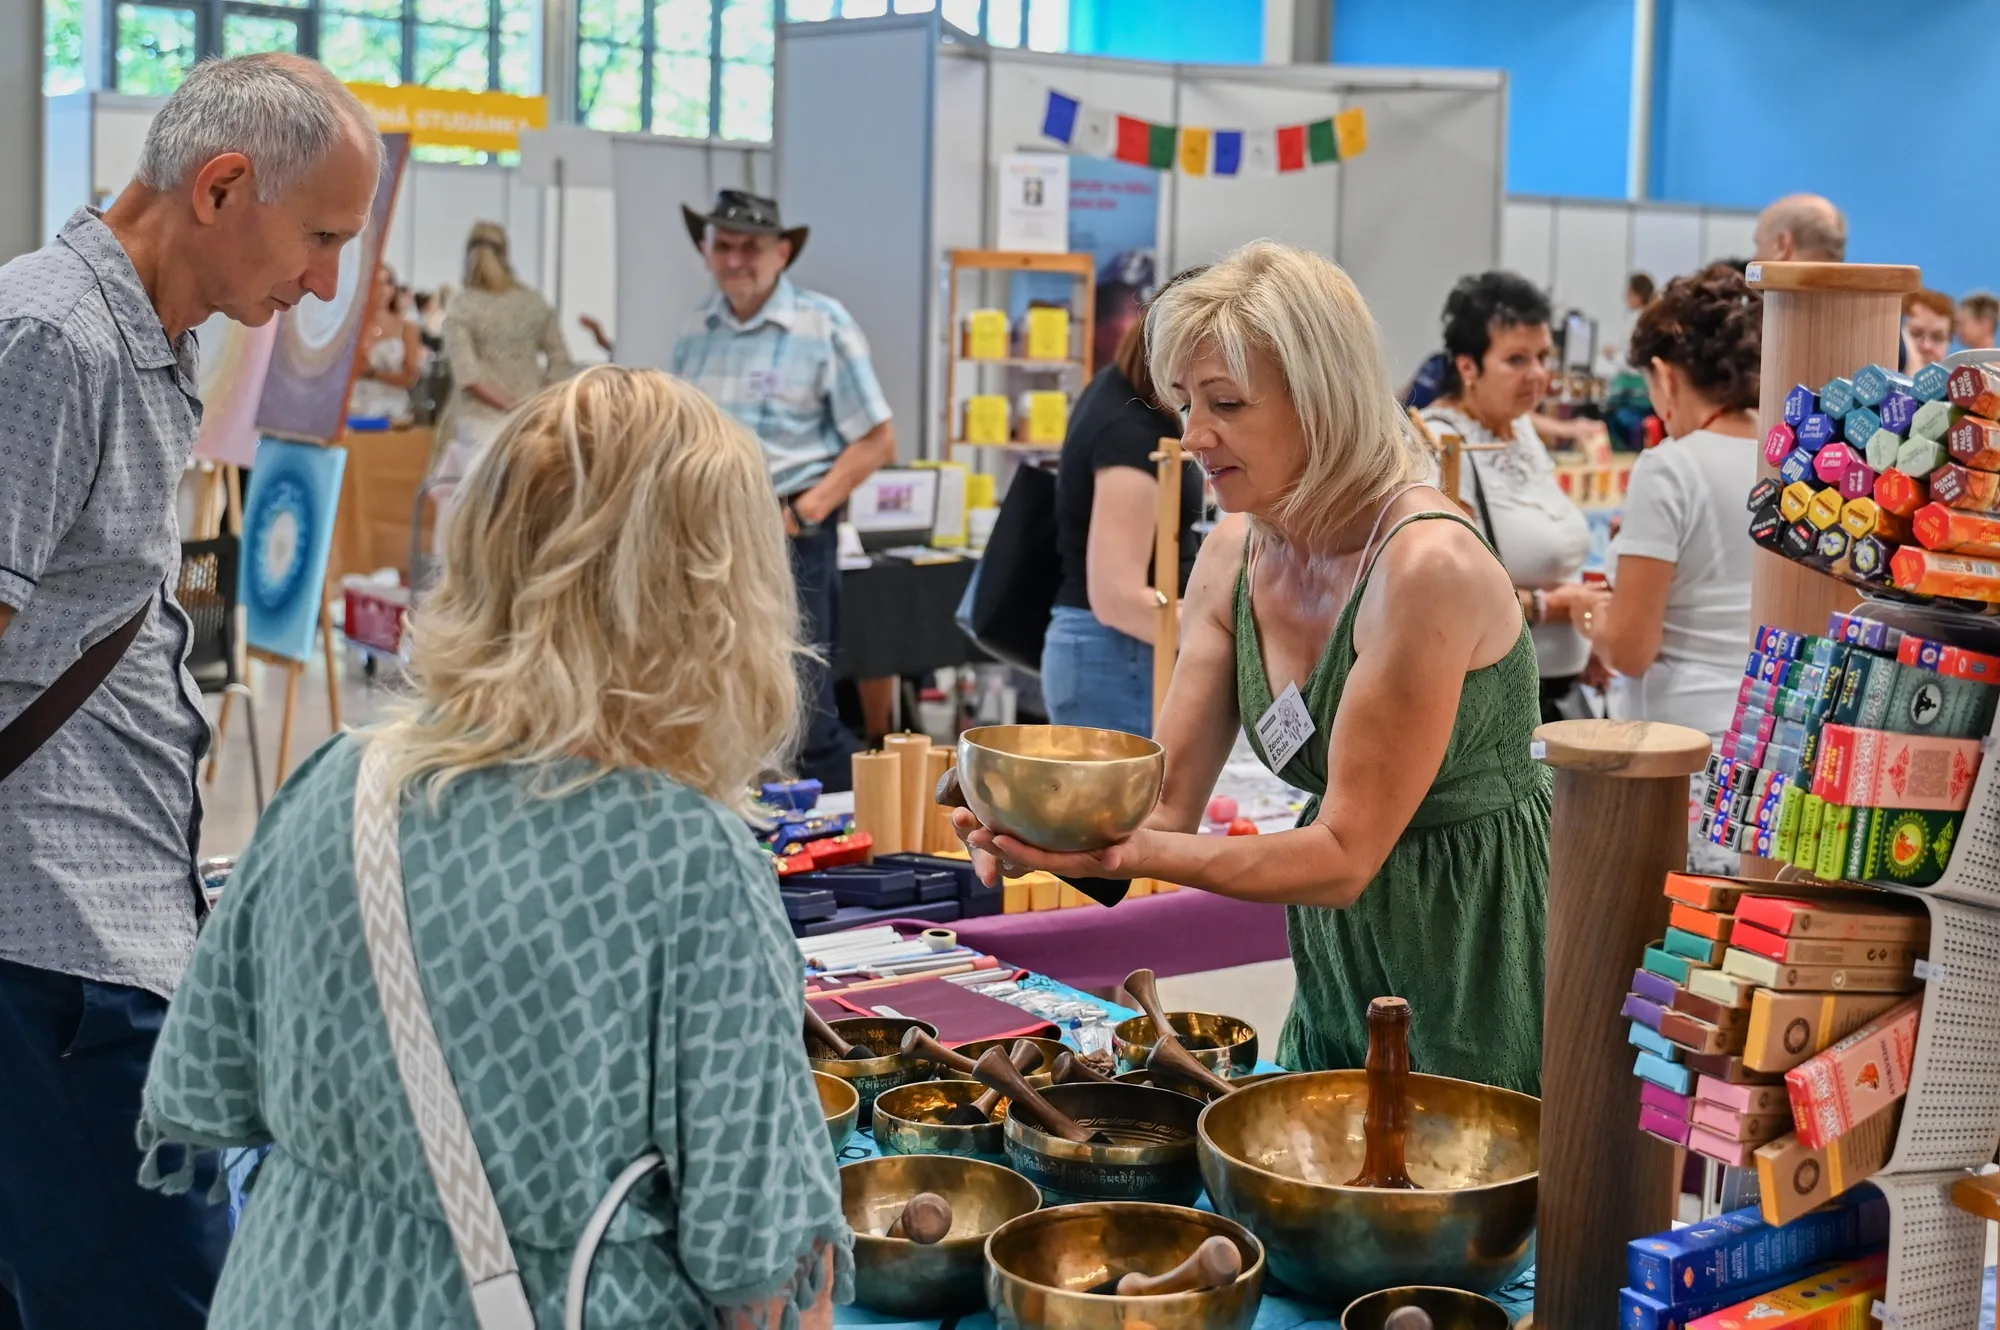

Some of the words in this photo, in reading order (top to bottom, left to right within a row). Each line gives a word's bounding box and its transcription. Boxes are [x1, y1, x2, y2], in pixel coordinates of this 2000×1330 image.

[1915, 373, 1943, 392] WHITE
[1958, 377, 1967, 397] PALO
[1963, 371, 1974, 397] SANTO
[1805, 424, 1820, 432] Royal
[1965, 425, 1974, 453] SANTO
[1782, 458, 1804, 481] ÓPIO
[1821, 459, 1841, 468] Lotus
[1934, 470, 1956, 490] SANTO
[1940, 478, 1957, 494] PALO
[1823, 666, 1840, 699] YOGA
[1841, 670, 1856, 704] YOGA
[1268, 730, 1284, 753] Zdraví
[1272, 754, 1278, 762] &
[1276, 740, 1289, 756] Duše
[1803, 734, 1816, 770] YOGA
[1780, 792, 1796, 852] PATCHOULI
[1802, 802, 1816, 862] PATCHOULI
[1822, 813, 1837, 873] PATCHOULI
[1880, 1037, 1896, 1095] AYURVEDIC
